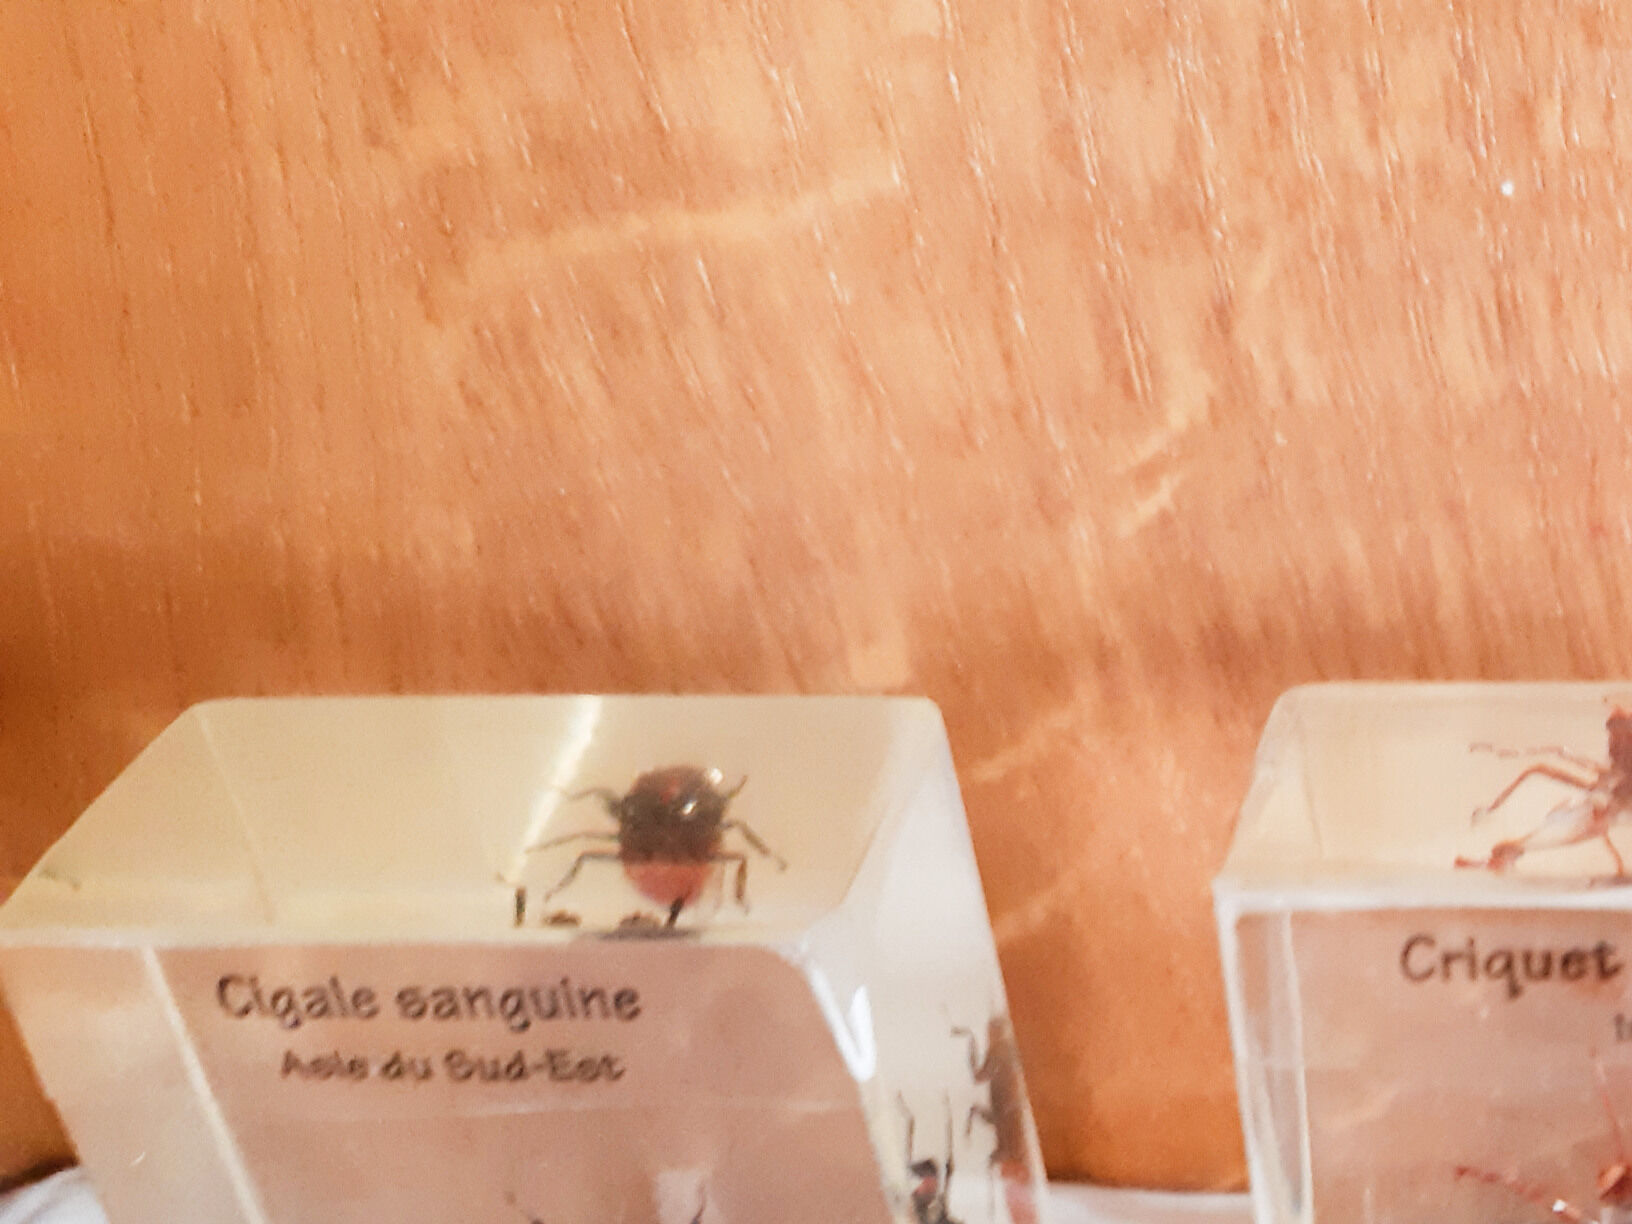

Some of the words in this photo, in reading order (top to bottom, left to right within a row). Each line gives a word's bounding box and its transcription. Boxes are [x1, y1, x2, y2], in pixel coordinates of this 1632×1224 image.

[1399, 934, 1625, 1000] Criquet
[215, 972, 381, 1030] Cigale
[394, 976, 643, 1033] sanguine
[380, 1049, 433, 1081] du
